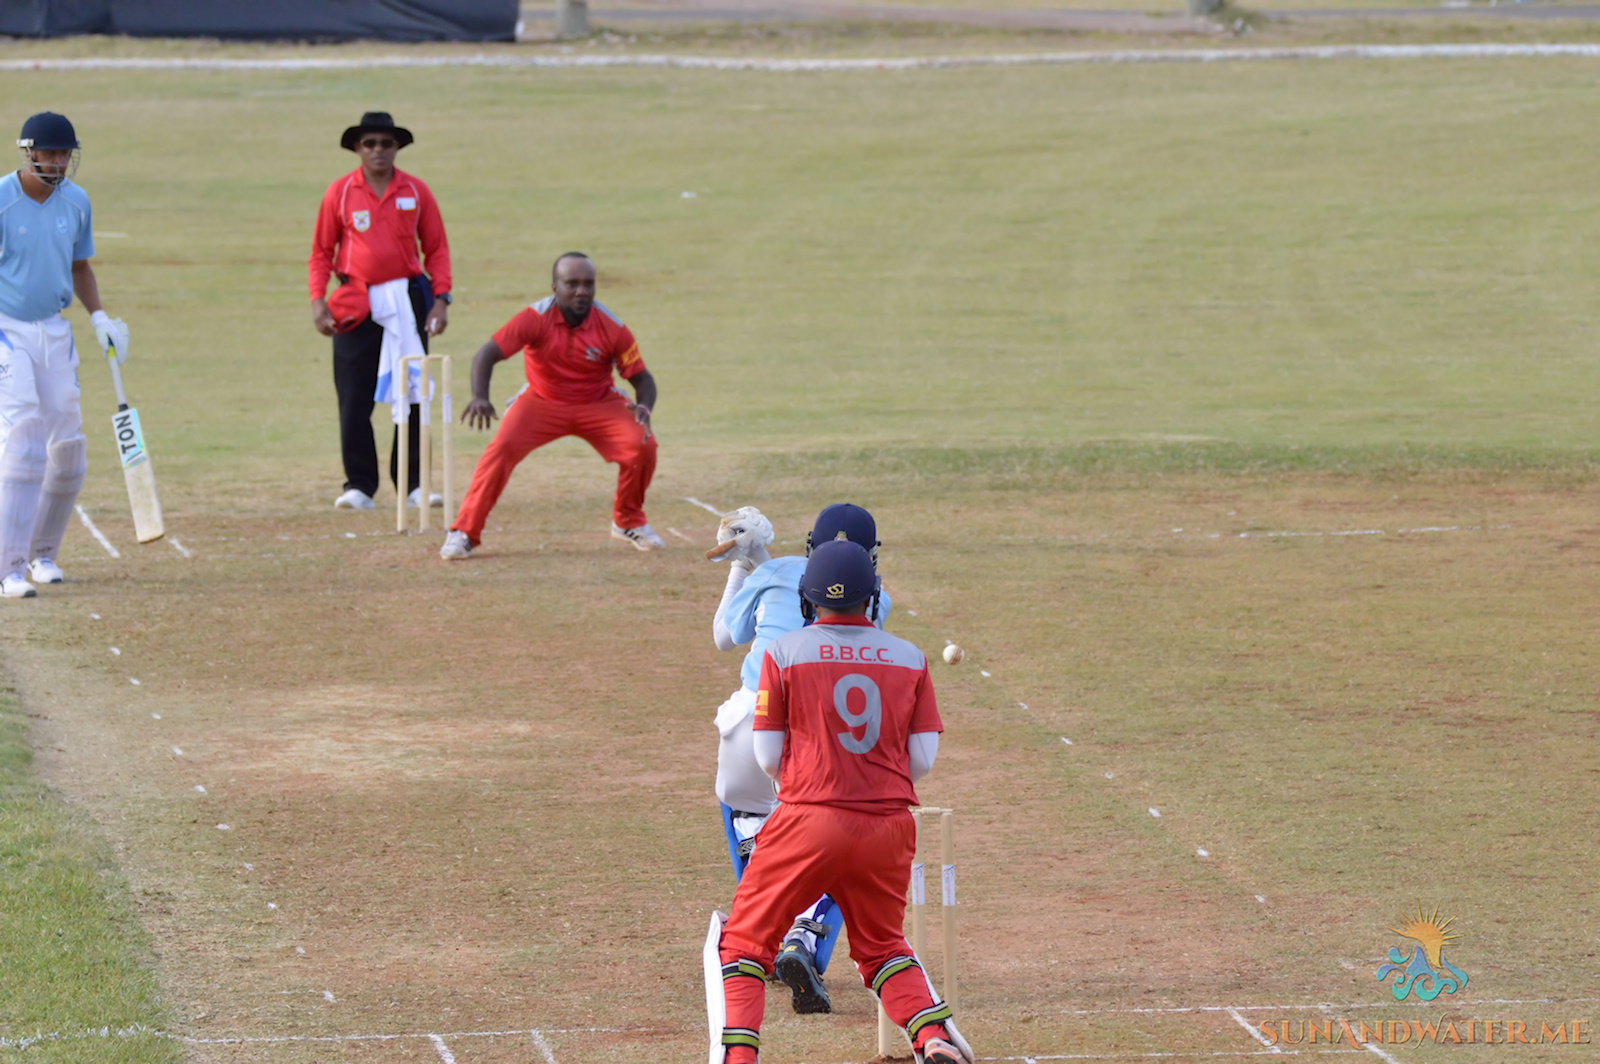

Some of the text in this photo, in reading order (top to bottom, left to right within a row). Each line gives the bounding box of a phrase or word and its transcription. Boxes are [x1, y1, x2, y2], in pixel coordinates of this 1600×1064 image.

[115, 414, 137, 454] TON
[820, 645, 894, 663] B.B.C.C.
[833, 673, 882, 755] 9
